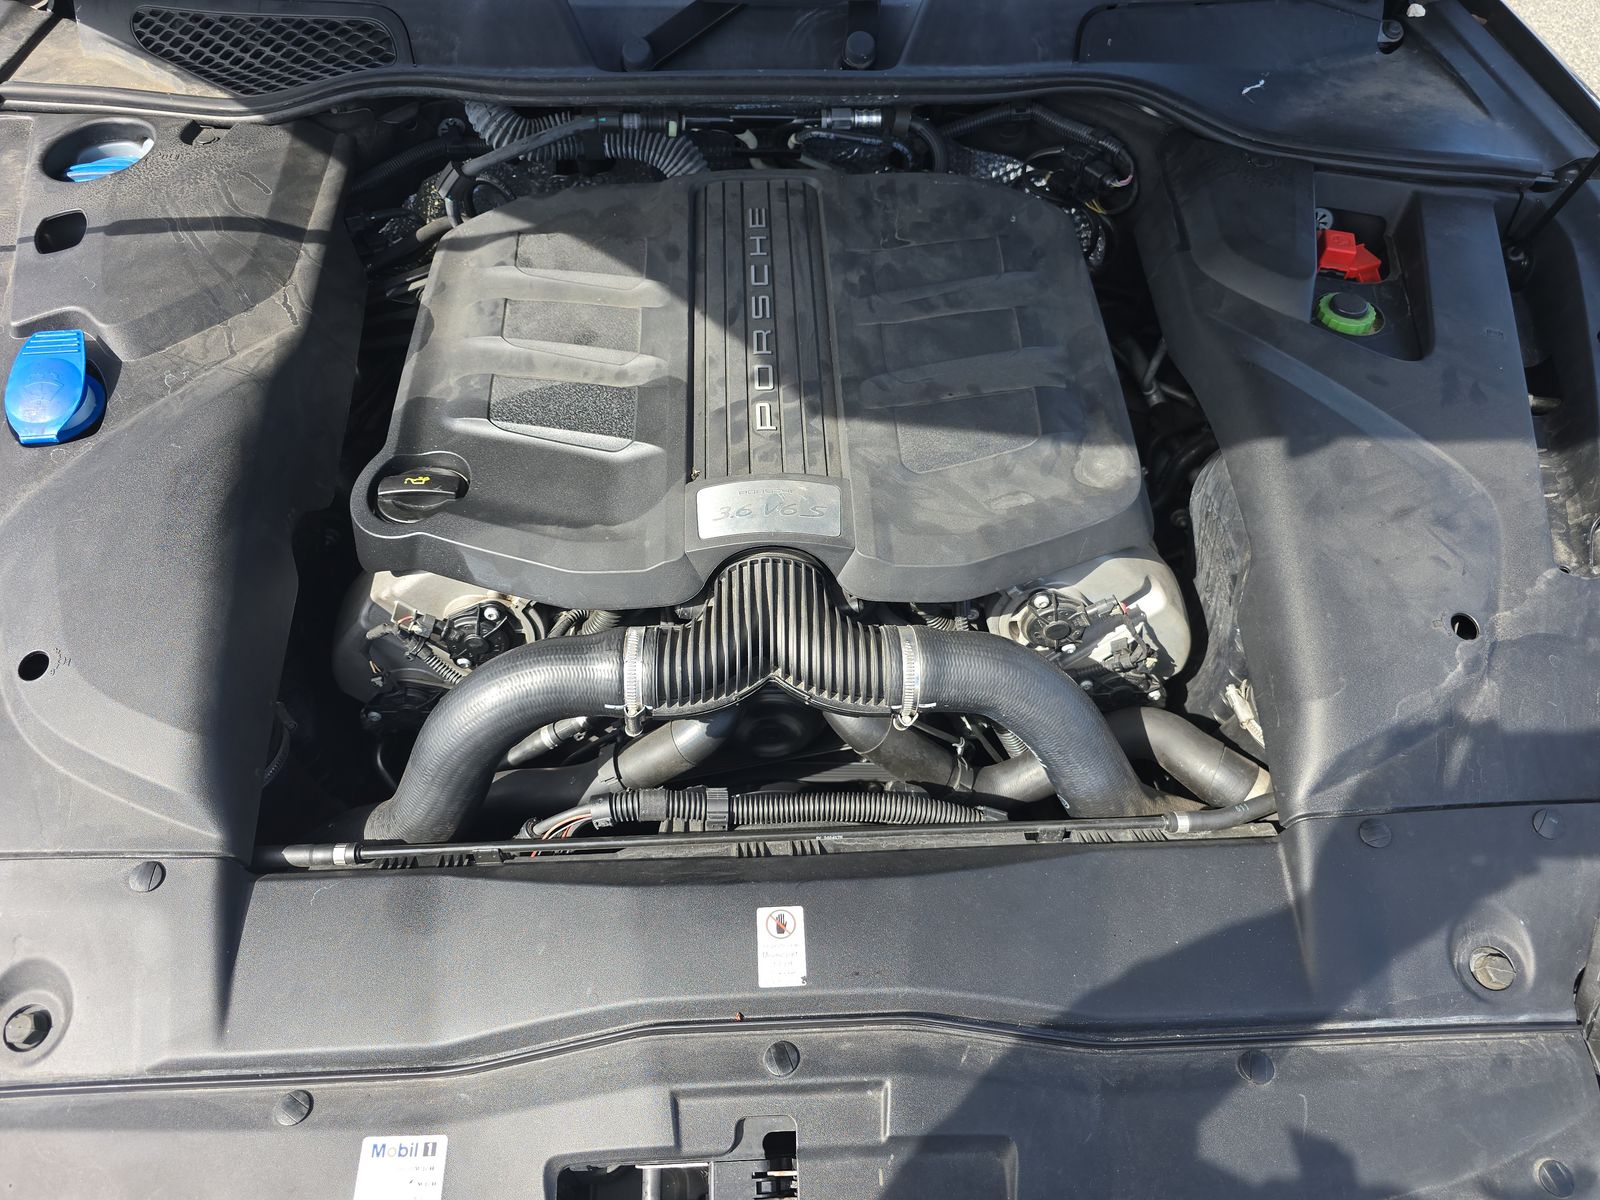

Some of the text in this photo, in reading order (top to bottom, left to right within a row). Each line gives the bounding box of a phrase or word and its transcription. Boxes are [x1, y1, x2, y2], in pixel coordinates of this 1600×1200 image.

[749, 208, 777, 431] PORSCHE
[712, 503, 827, 521] 3.6 V6 S
[371, 1142, 418, 1158] Mobil
